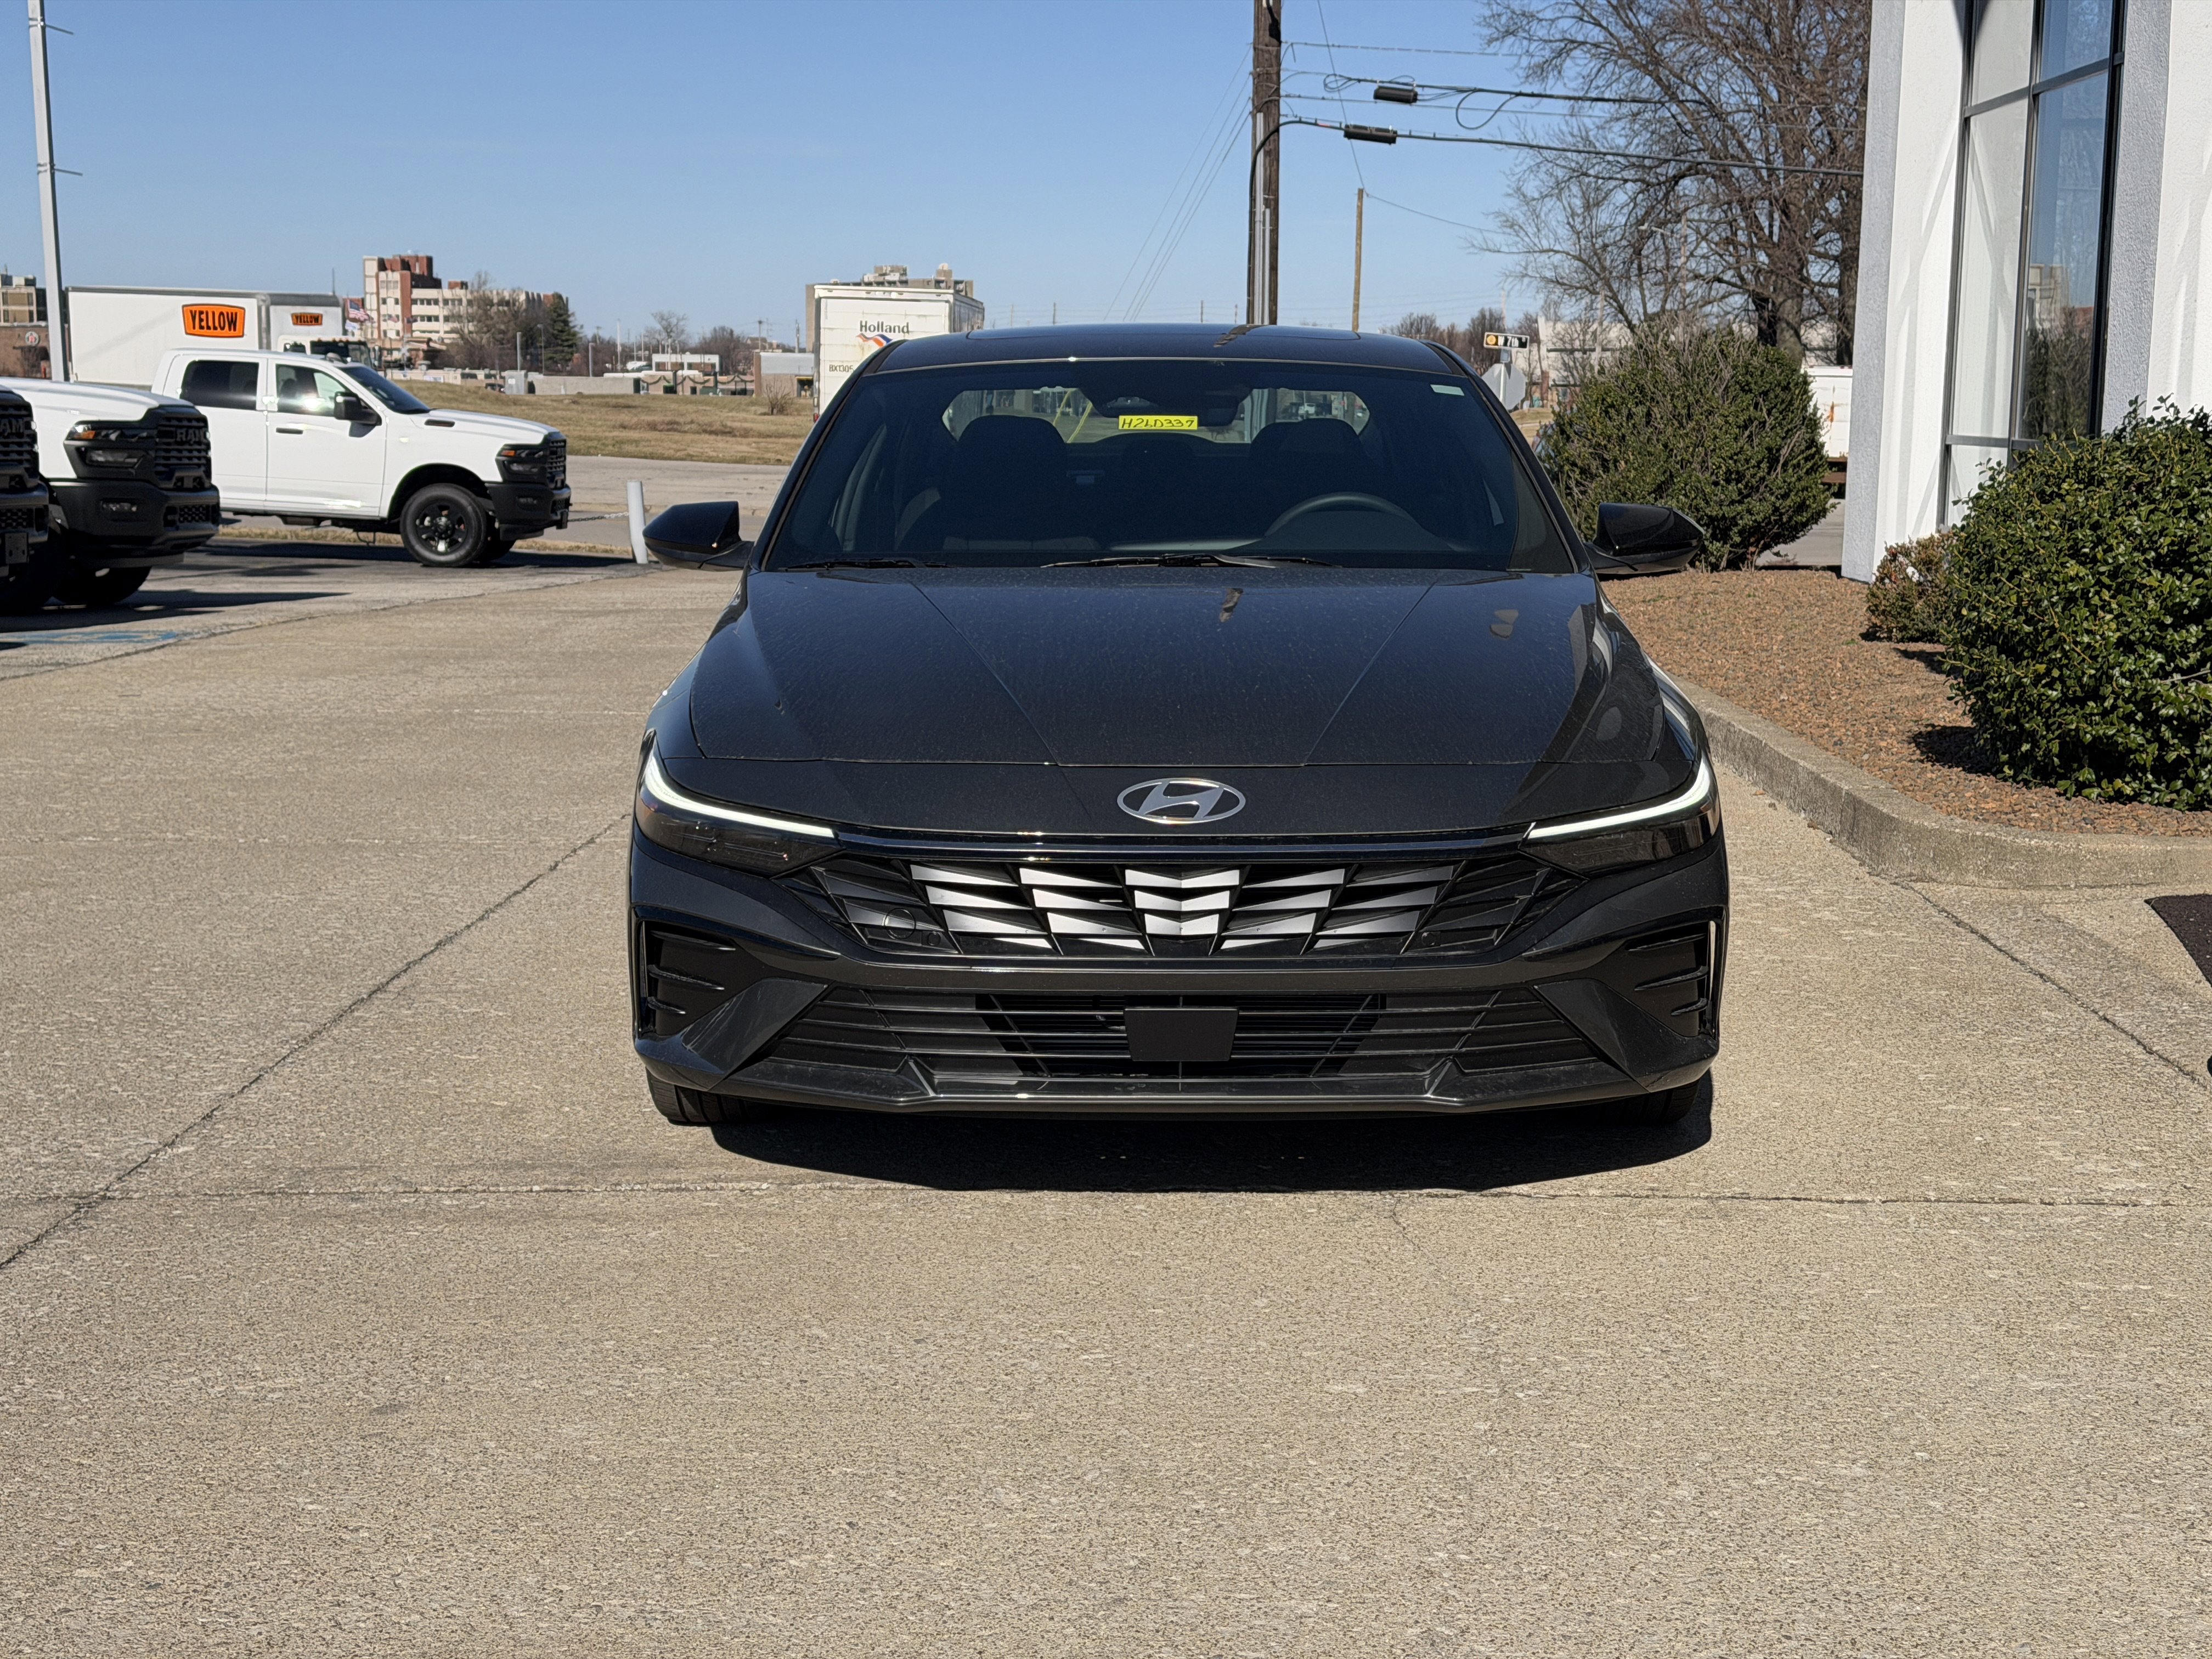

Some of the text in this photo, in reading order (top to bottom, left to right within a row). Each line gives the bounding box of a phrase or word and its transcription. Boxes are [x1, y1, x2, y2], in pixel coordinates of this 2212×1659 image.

[189, 309, 238, 332] YELLOW
[295, 315, 319, 324] YELLOW
[859, 320, 910, 334] Holland
[1498, 335, 1505, 346] W
[1507, 336, 1519, 347] 7th
